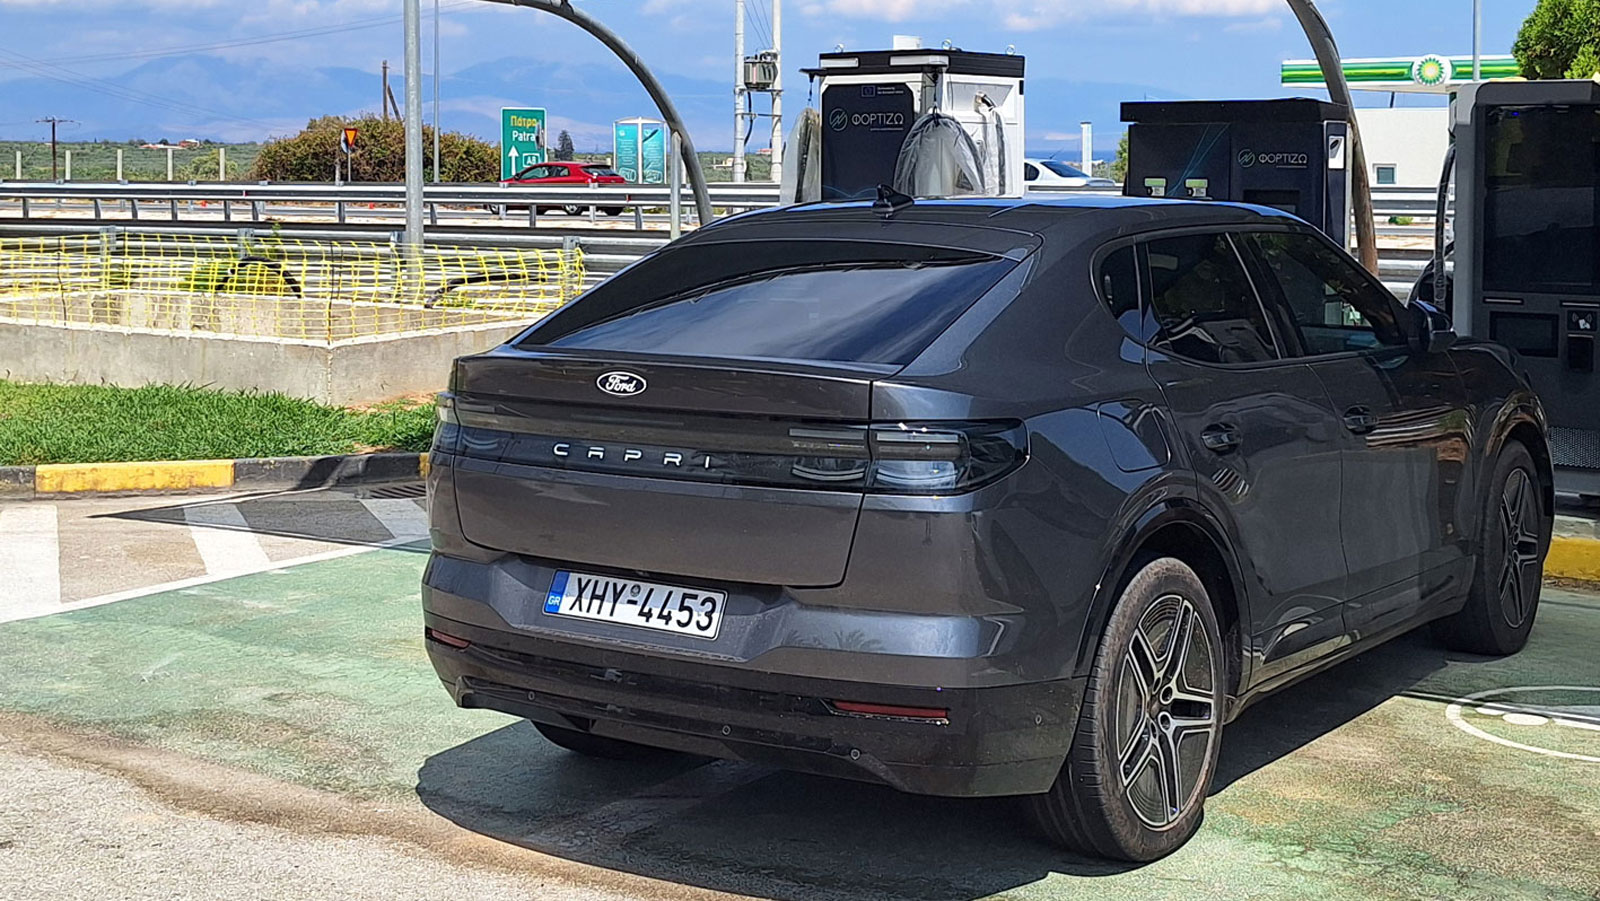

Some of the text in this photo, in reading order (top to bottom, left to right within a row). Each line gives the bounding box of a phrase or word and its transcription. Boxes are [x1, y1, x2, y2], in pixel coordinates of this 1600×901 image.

[510, 115, 537, 129] Πάτρα
[851, 112, 904, 125] ΦΟΡΤΙΖΩ
[512, 130, 536, 142] Patra
[1258, 152, 1308, 164] ΦΟΡΤΙΖΩ
[605, 374, 636, 393] Ford
[553, 443, 711, 469] CAPRI
[547, 594, 561, 607] GR
